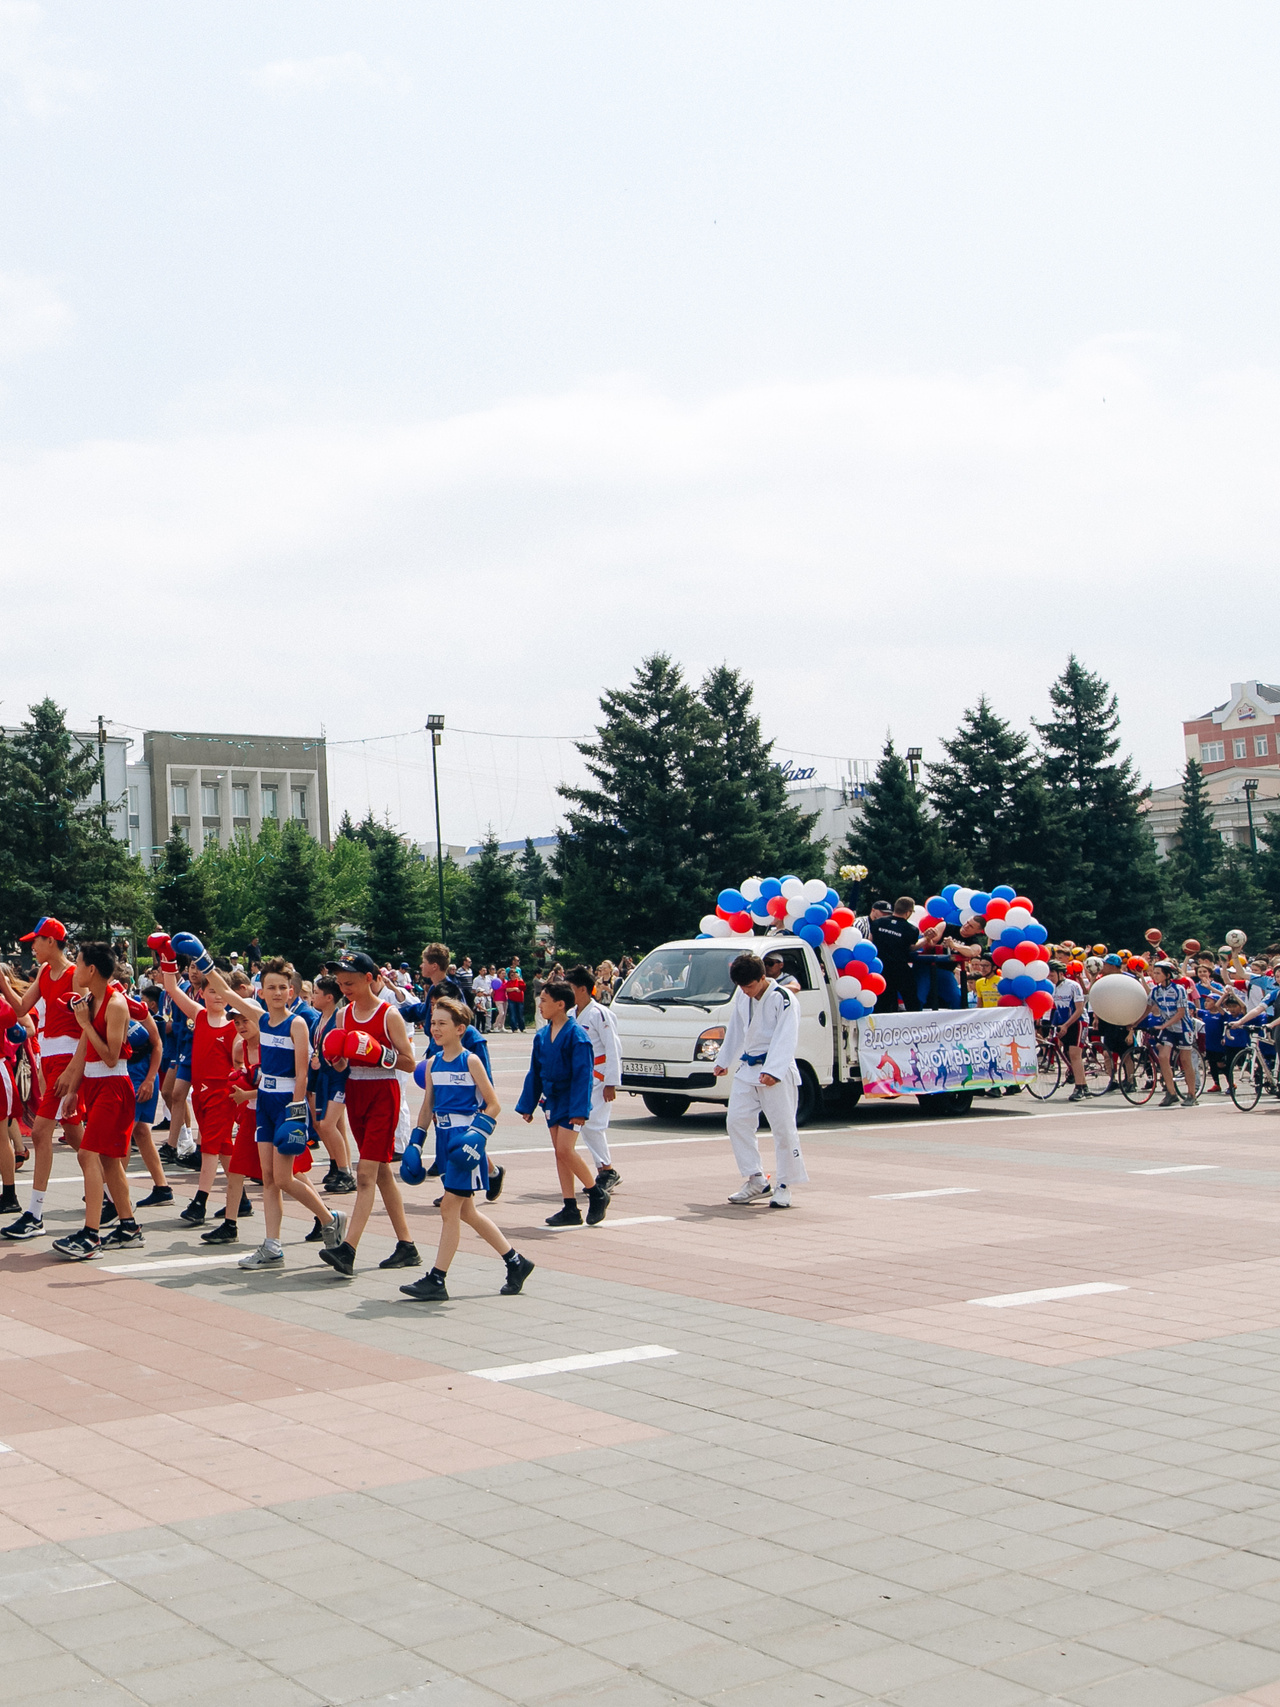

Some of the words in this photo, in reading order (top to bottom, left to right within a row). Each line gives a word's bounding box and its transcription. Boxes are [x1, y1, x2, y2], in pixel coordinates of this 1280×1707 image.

[864, 1022, 941, 1050] ЗДОРОВЫЙ
[943, 1020, 985, 1041] ОБРАЗ
[984, 1018, 1032, 1039] ЖИЗНИ
[916, 1046, 952, 1069] МОЙ
[954, 1046, 1001, 1066] ВЫБОР!
